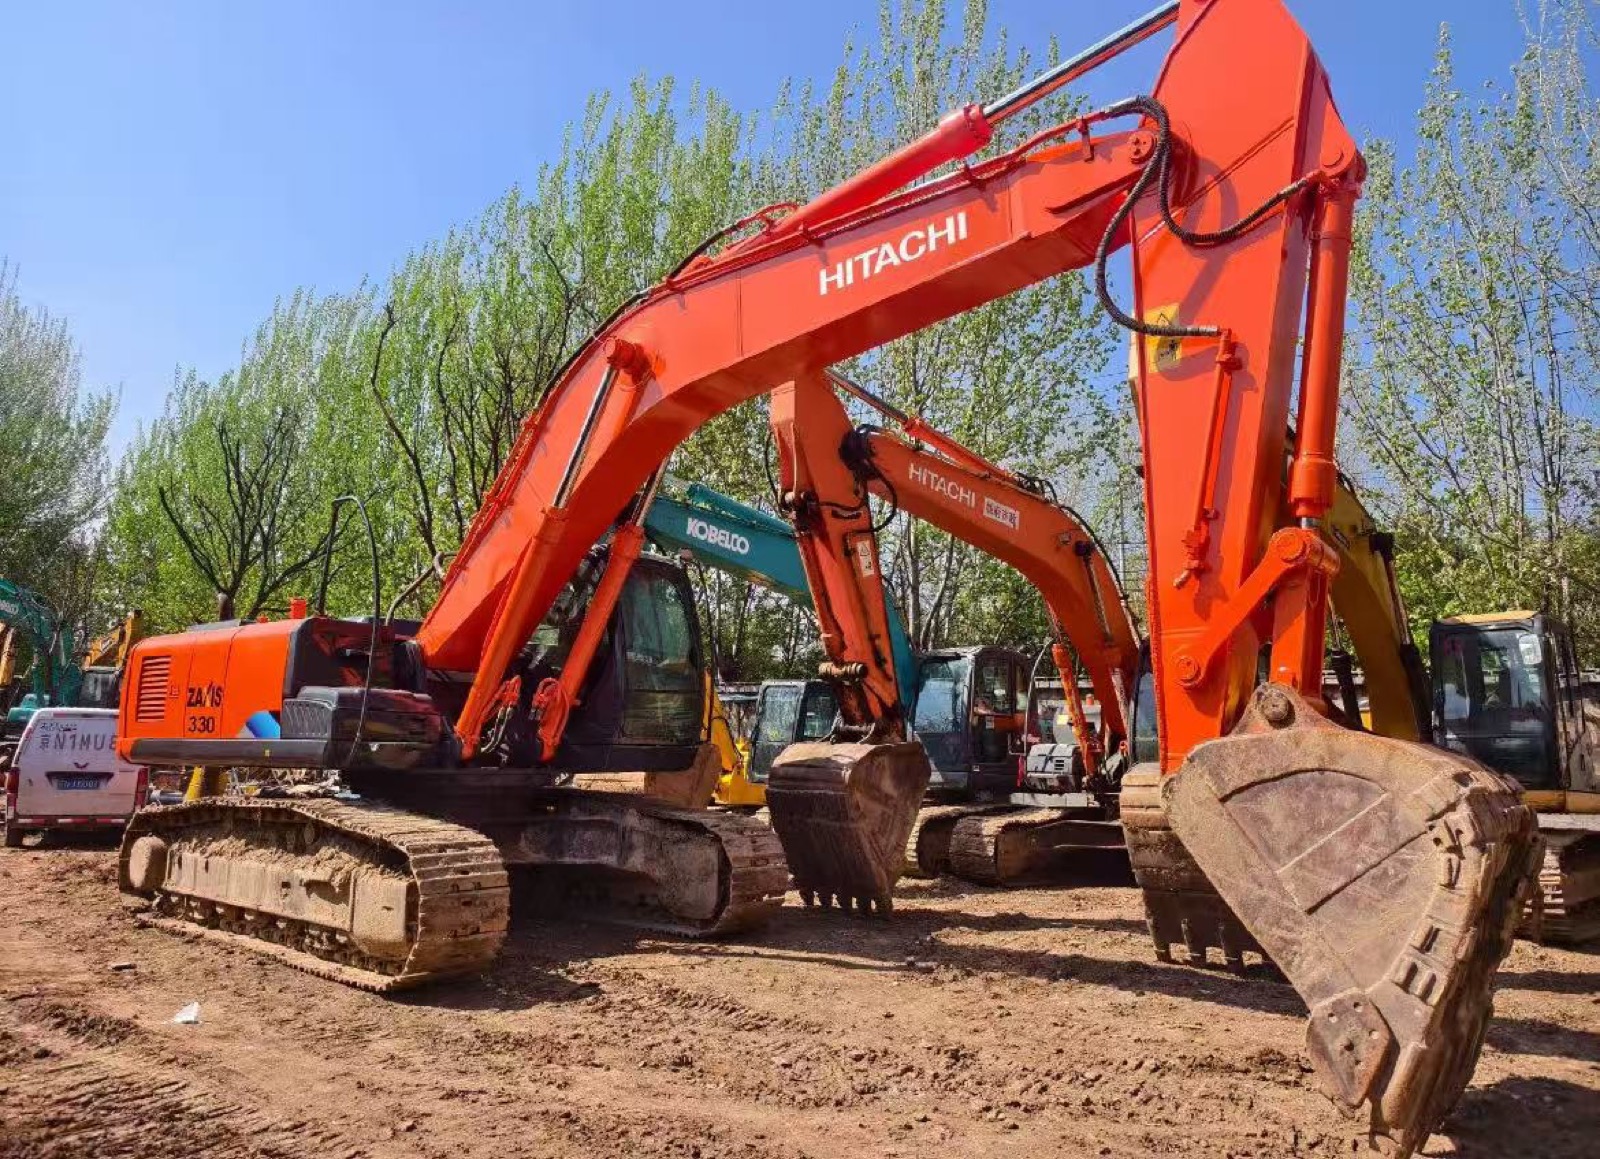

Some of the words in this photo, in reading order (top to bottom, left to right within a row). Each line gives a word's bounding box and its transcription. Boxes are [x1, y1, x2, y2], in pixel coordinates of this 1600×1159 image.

[819, 212, 968, 295] HITACHI
[908, 462, 976, 509] HITACHI
[686, 517, 750, 555] KOBELCO
[188, 715, 216, 733] 330
